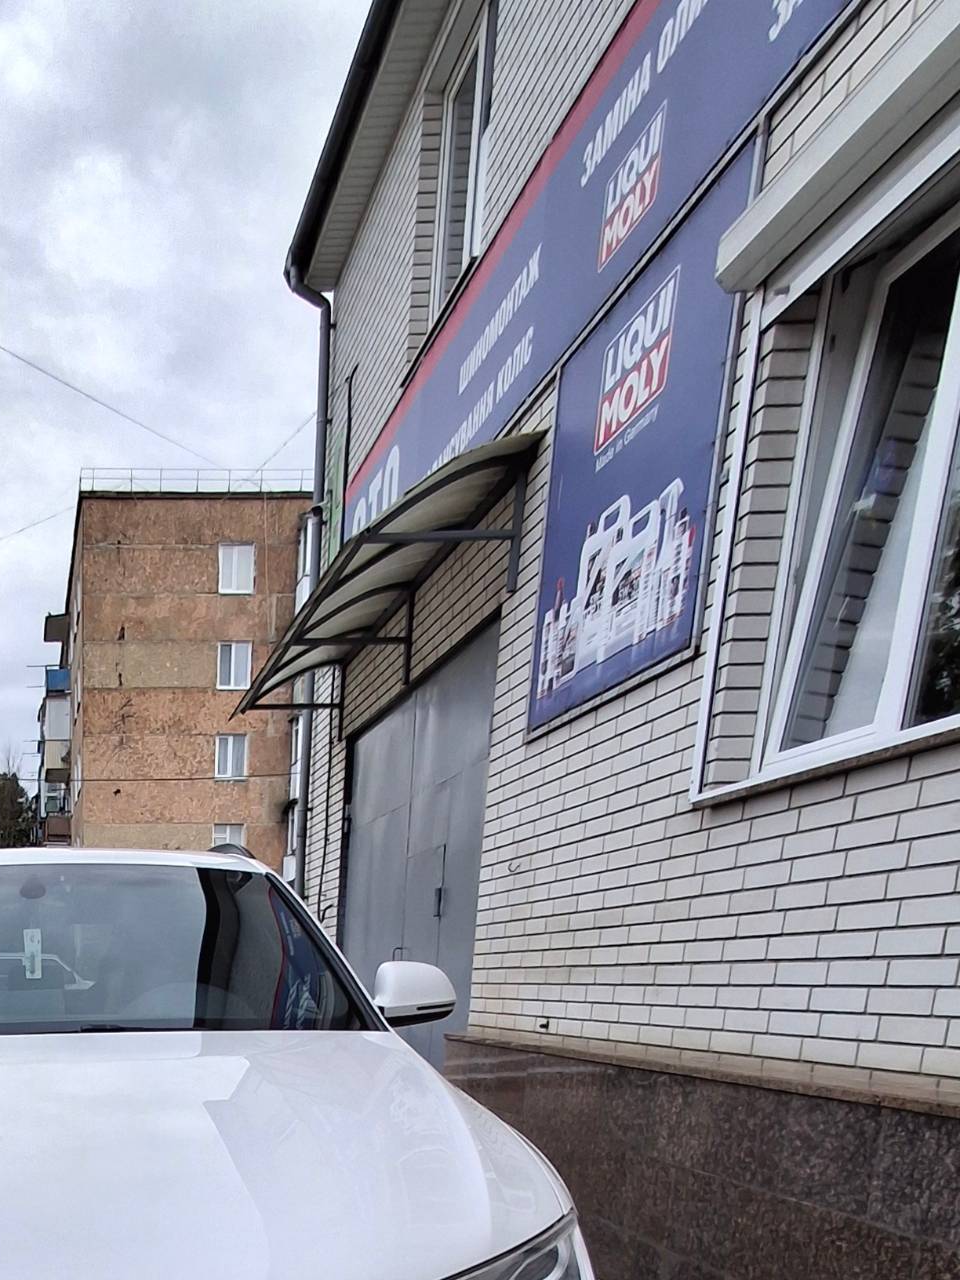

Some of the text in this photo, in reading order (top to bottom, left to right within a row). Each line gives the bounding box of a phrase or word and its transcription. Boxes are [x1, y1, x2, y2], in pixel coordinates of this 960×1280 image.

[581, 0, 708, 187] ЗАМІНА ОЛИ
[602, 162, 658, 258] MOLY
[607, 112, 663, 211] LIQUI
[458, 242, 542, 394] ШИНОМОНТАЖ
[495, 326, 534, 405] КОЛІС
[604, 278, 673, 385] LIQUI
[597, 338, 670, 447] MOLY
